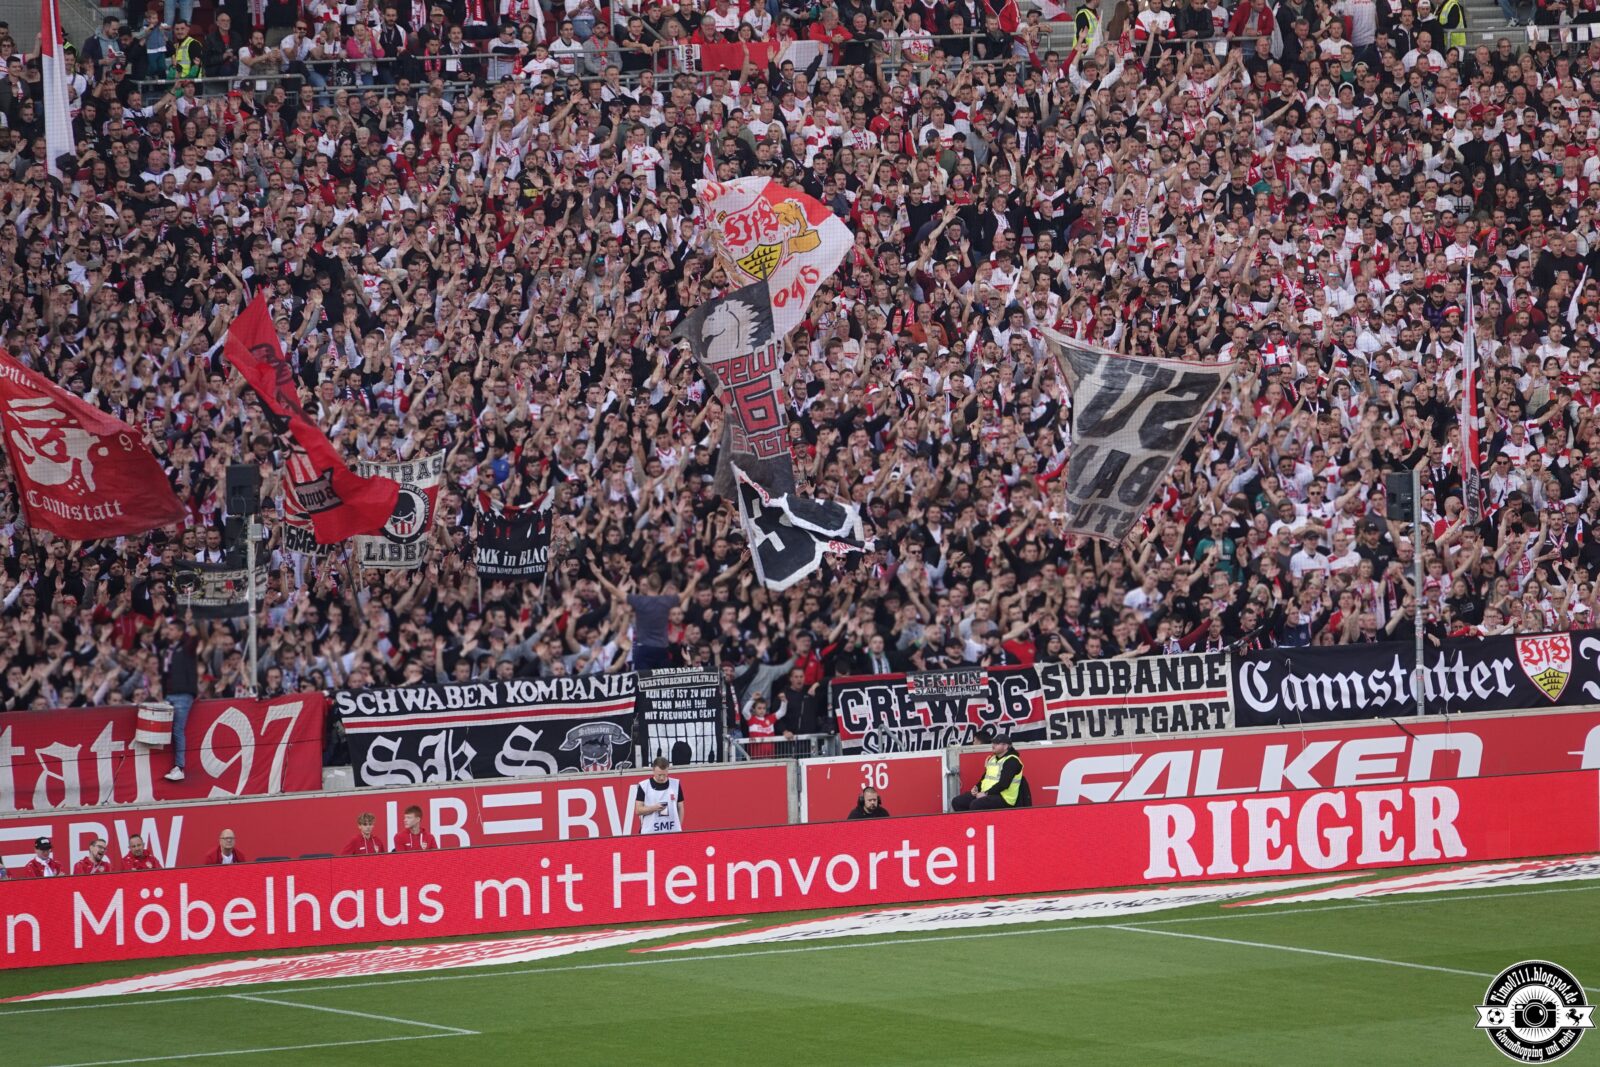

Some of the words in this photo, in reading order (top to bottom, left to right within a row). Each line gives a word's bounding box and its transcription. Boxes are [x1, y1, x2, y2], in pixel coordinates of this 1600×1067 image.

[27, 490, 123, 522] Cannstatt
[503, 551, 516, 566] in
[335, 683, 500, 716] SCHWABEN
[504, 672, 636, 704] KOMPANIE
[640, 677, 691, 688] VERSTORBENEN
[692, 674, 718, 683] ULTRAS
[676, 689, 688, 698] IST
[700, 688, 717, 698] WEIT
[1239, 650, 1515, 713] Cannstatter
[644, 711, 657, 720] MIT
[659, 710, 698, 720] FREUNDEN
[838, 683, 969, 735] CREW
[1050, 701, 1230, 740] STUTTGART
[200, 701, 304, 797] 97
[860, 762, 889, 790] 36
[1043, 732, 1484, 806] FALKEN
[653, 821, 675, 831] SMF
[1144, 786, 1468, 880] RIEGER
[74, 875, 446, 949] Möbelhaus
[474, 857, 584, 919] mit
[612, 824, 996, 910] Heimvorteil
